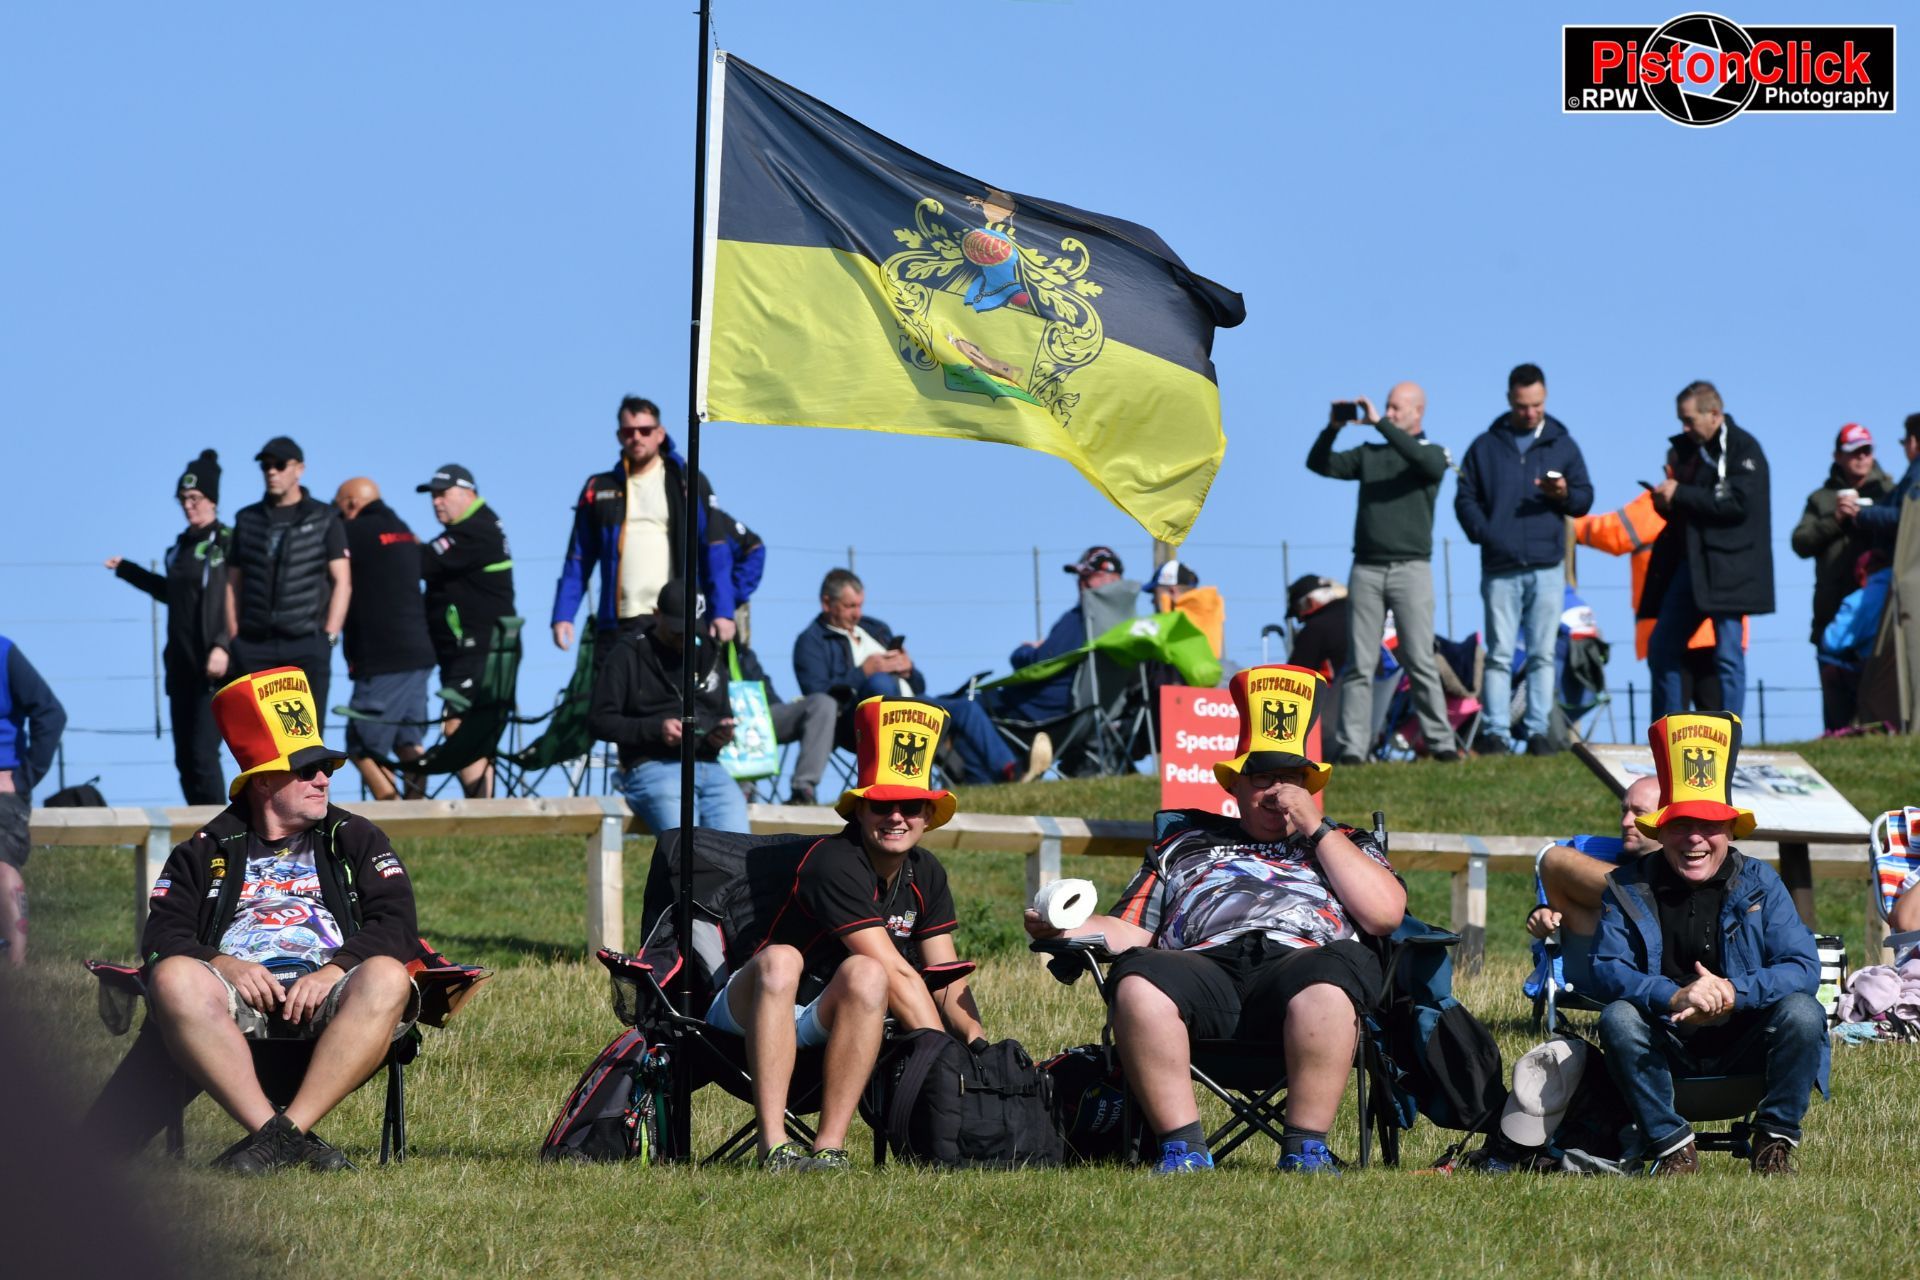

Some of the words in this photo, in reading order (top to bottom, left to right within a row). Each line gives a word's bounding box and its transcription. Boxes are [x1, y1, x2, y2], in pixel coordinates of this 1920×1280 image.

[258, 677, 308, 701] DEUTSCHLAND
[1250, 676, 1312, 701] DEUTSCHLAND
[883, 709, 940, 735] DEUTSCHLAND
[1672, 725, 1728, 747] DEUTSCHLAND
